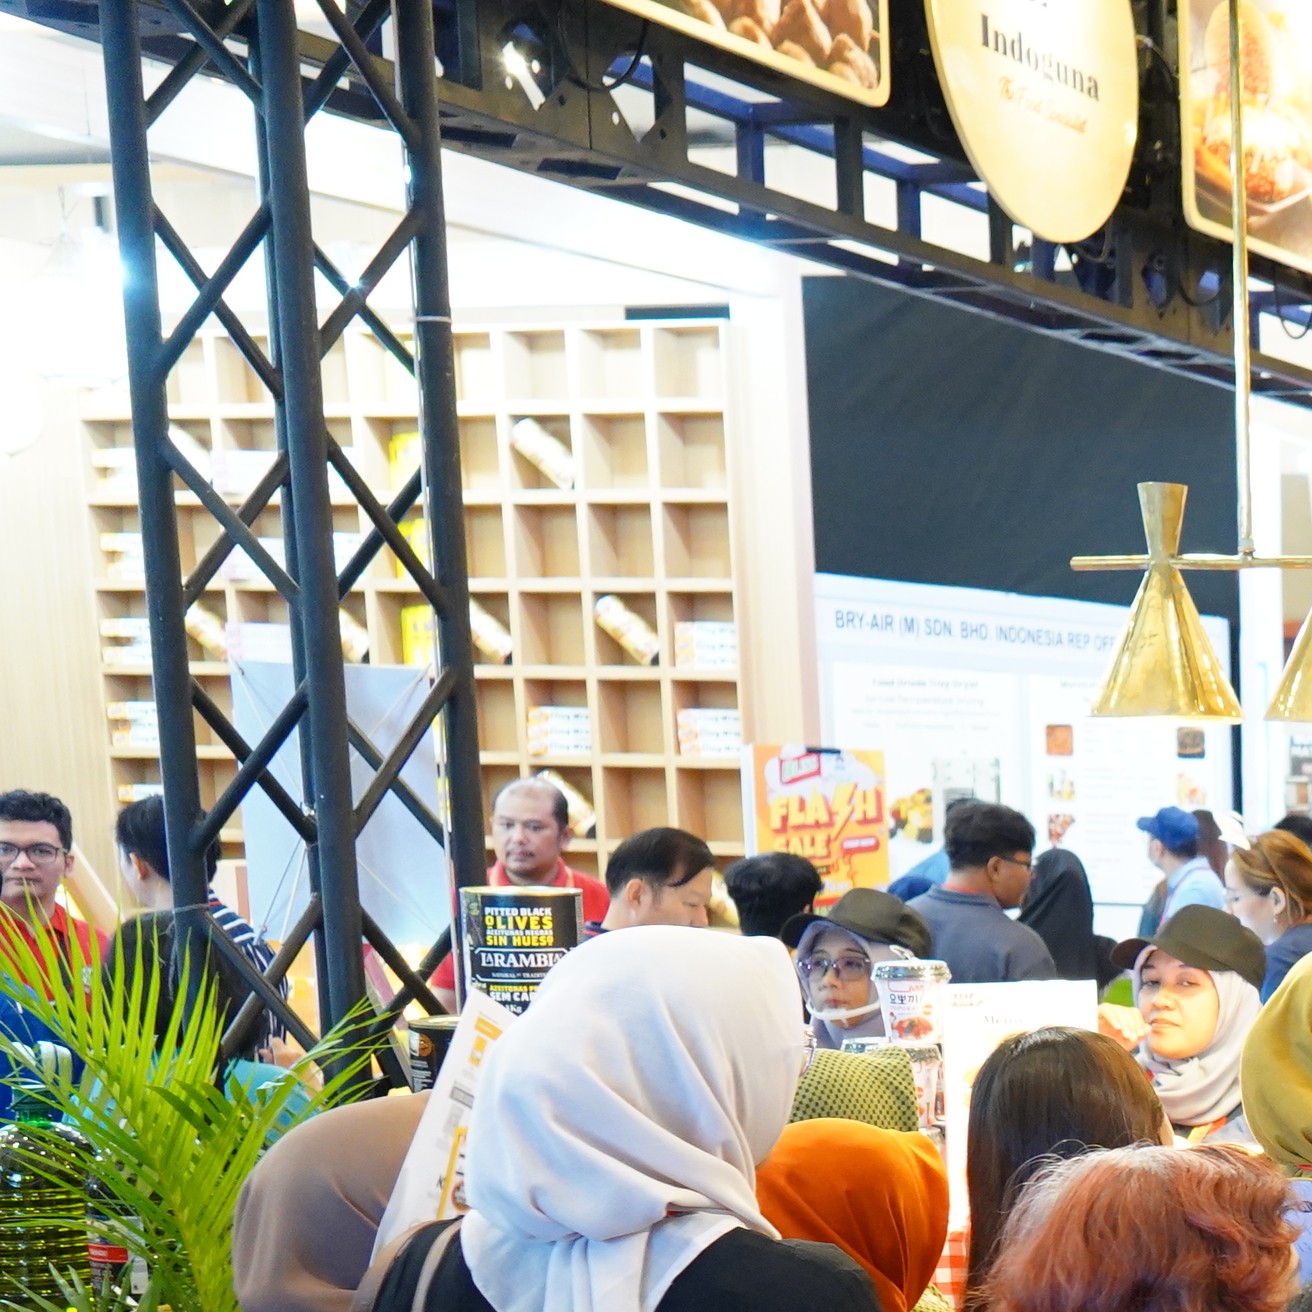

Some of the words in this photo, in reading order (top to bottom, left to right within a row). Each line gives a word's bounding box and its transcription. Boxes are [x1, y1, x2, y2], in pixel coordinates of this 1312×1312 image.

[981, 13, 1099, 101] Indoguna
[835, 610, 894, 632] BRY-AIR
[899, 616, 920, 639] (M)
[995, 625, 1063, 647] INDONESIA
[1067, 631, 1090, 650] REP
[773, 833, 832, 860] SALE
[485, 907, 519, 916] PITTED
[520, 907, 552, 916] BLACK
[484, 915, 553, 930] OLIVES
[486, 936, 507, 946] SIN
